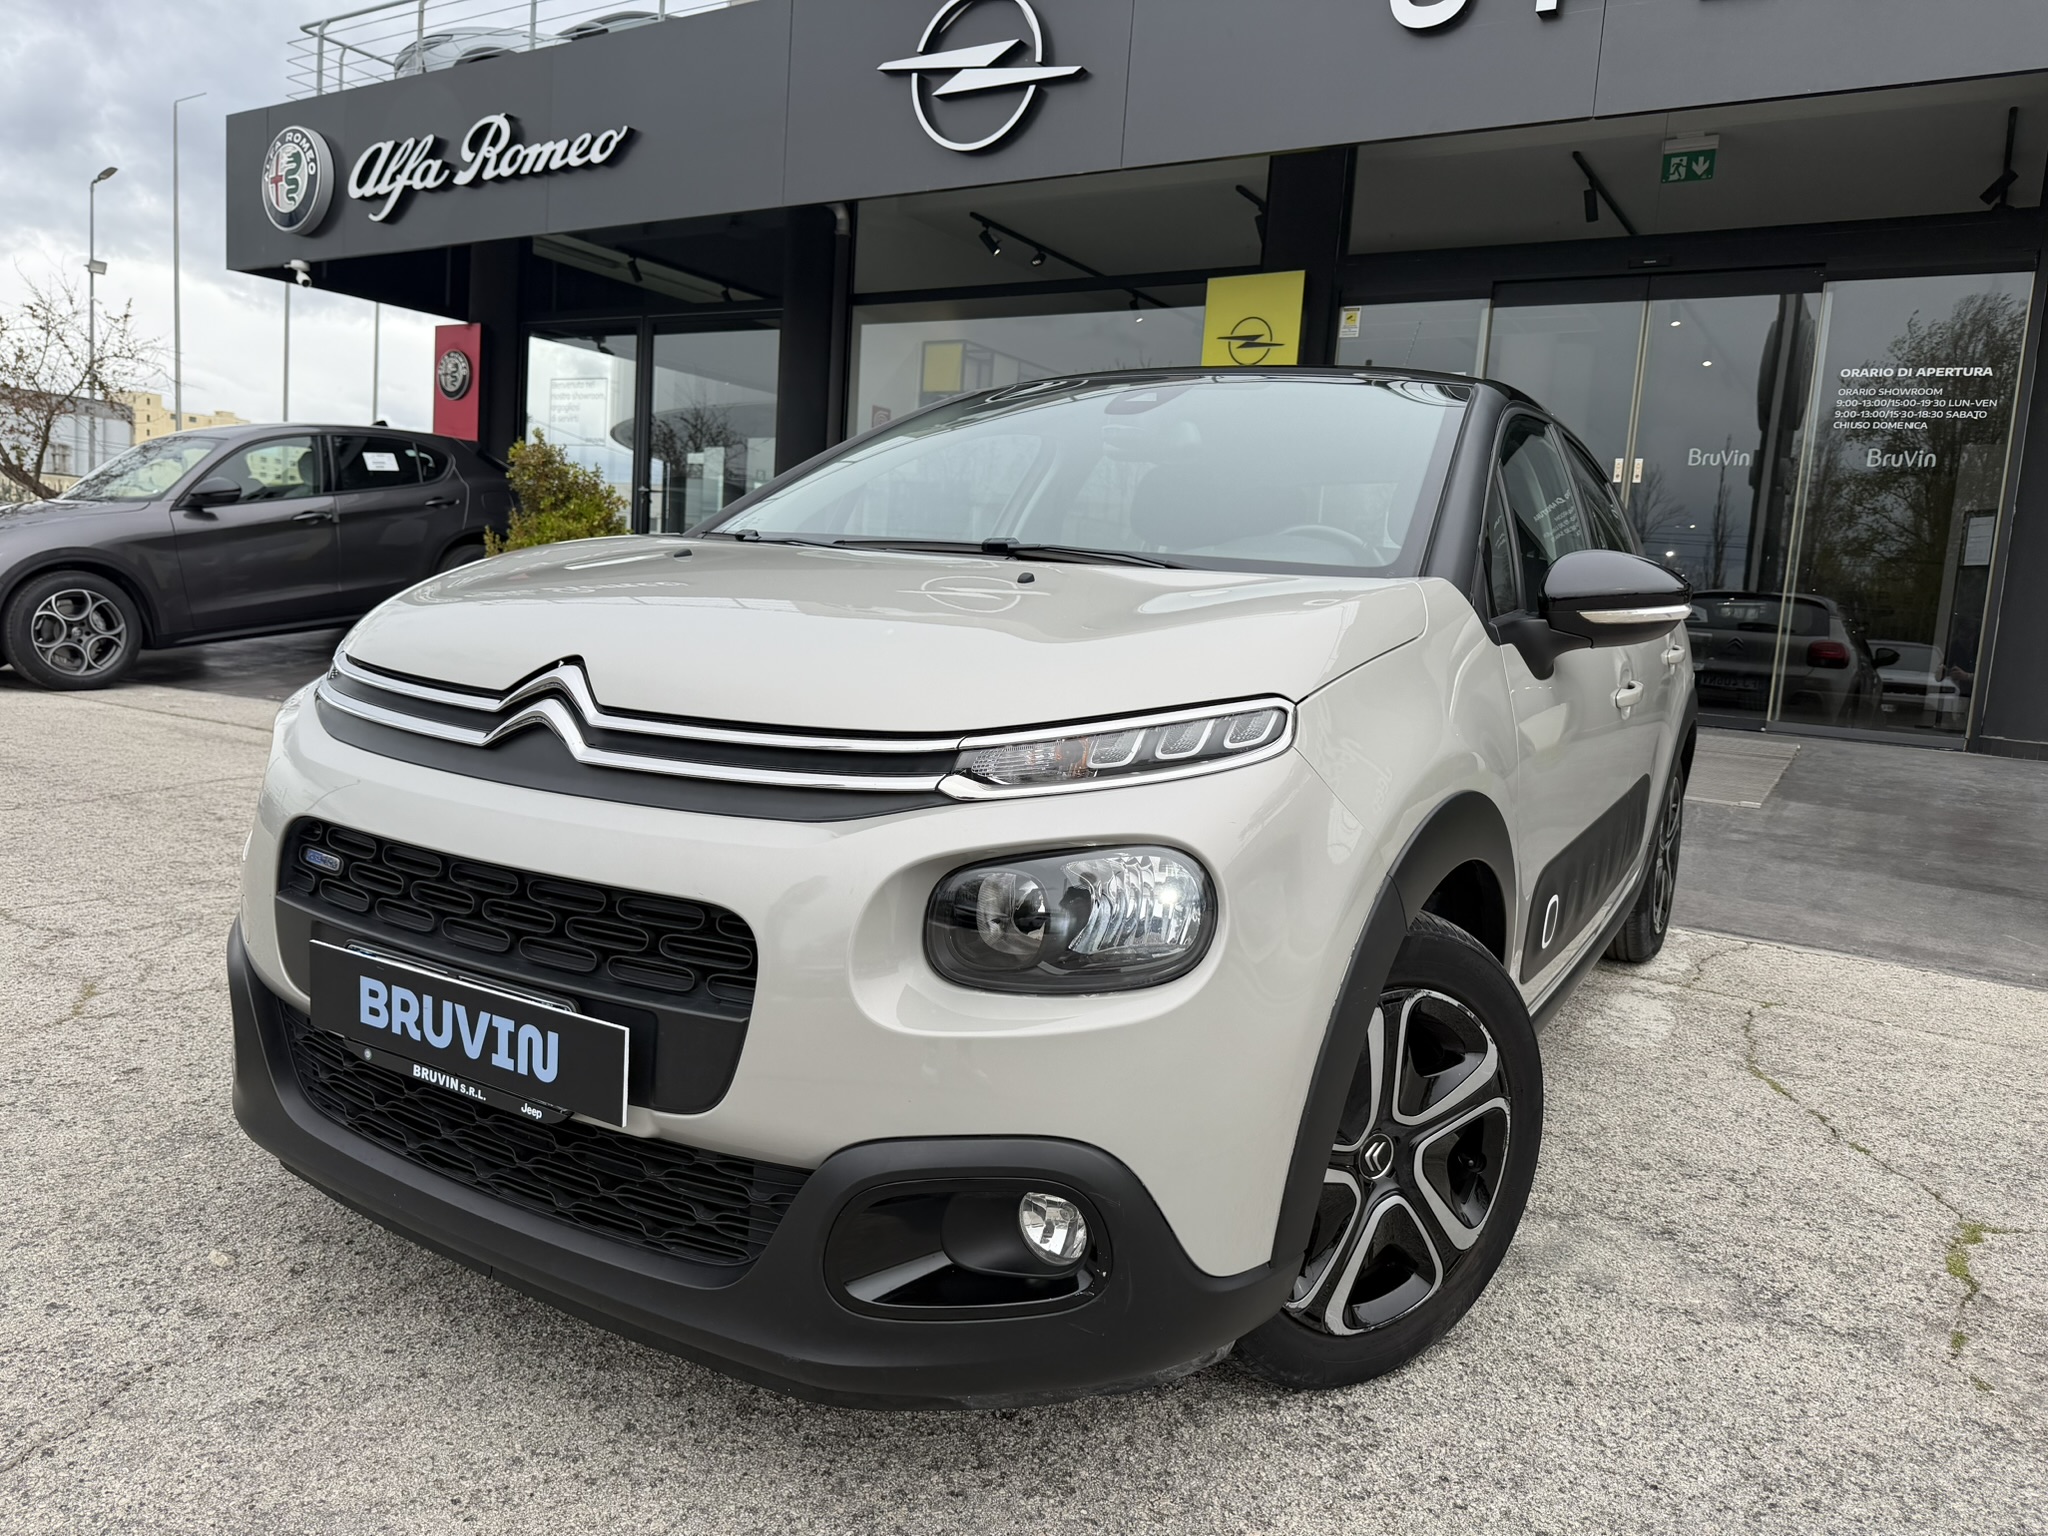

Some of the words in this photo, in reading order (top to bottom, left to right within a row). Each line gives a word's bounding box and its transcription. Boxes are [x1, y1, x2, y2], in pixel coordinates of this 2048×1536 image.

[285, 132, 317, 175] ROMEO
[348, 134, 450, 222] Alfa
[453, 113, 629, 186] Romeo
[1840, 368, 1894, 378] ORARIO
[1897, 367, 1913, 377] DI
[1915, 367, 1994, 377] APERTURA
[1838, 388, 1877, 396] ORARIO
[1878, 388, 1943, 396] SHOWROOM
[1948, 399, 1998, 407] LUN-VEN
[1833, 421, 1870, 430] CHIUSO
[1872, 421, 1928, 430] DOMENICA
[1687, 447, 1750, 466] BruVin
[1866, 448, 1937, 468] BruVin
[359, 975, 559, 1083] BRUVIN
[412, 1063, 459, 1092] BRUVIN
[521, 1102, 543, 1120] Jeep
